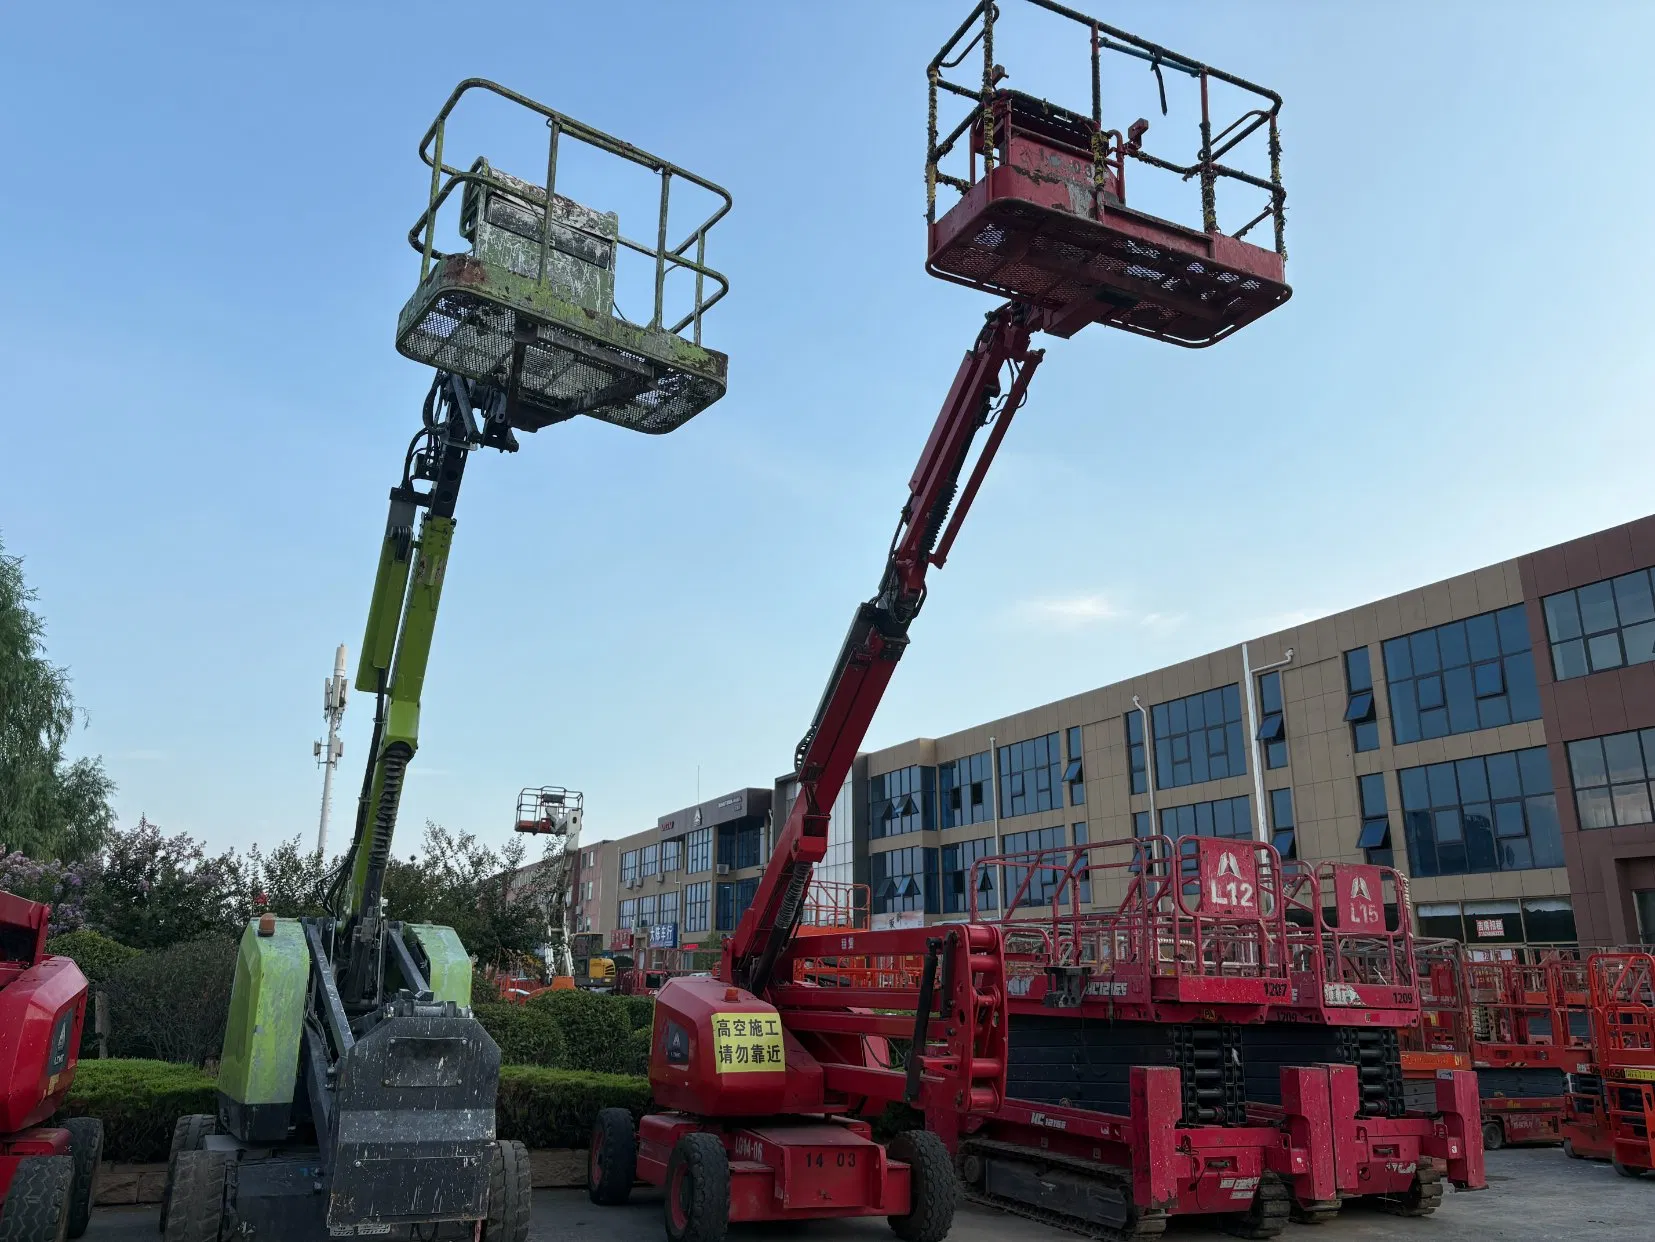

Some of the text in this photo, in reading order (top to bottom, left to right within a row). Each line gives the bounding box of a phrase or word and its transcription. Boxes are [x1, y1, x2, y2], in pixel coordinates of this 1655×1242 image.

[1211, 879, 1253, 907] L12
[1350, 902, 1378, 924] L15
[1263, 982, 1287, 997] 1207
[1392, 991, 1413, 1004] 1209
[716, 1018, 779, 1038] 高空施工
[718, 1044, 781, 1064] 请勿靠近
[806, 1151, 856, 1168] 14 03
